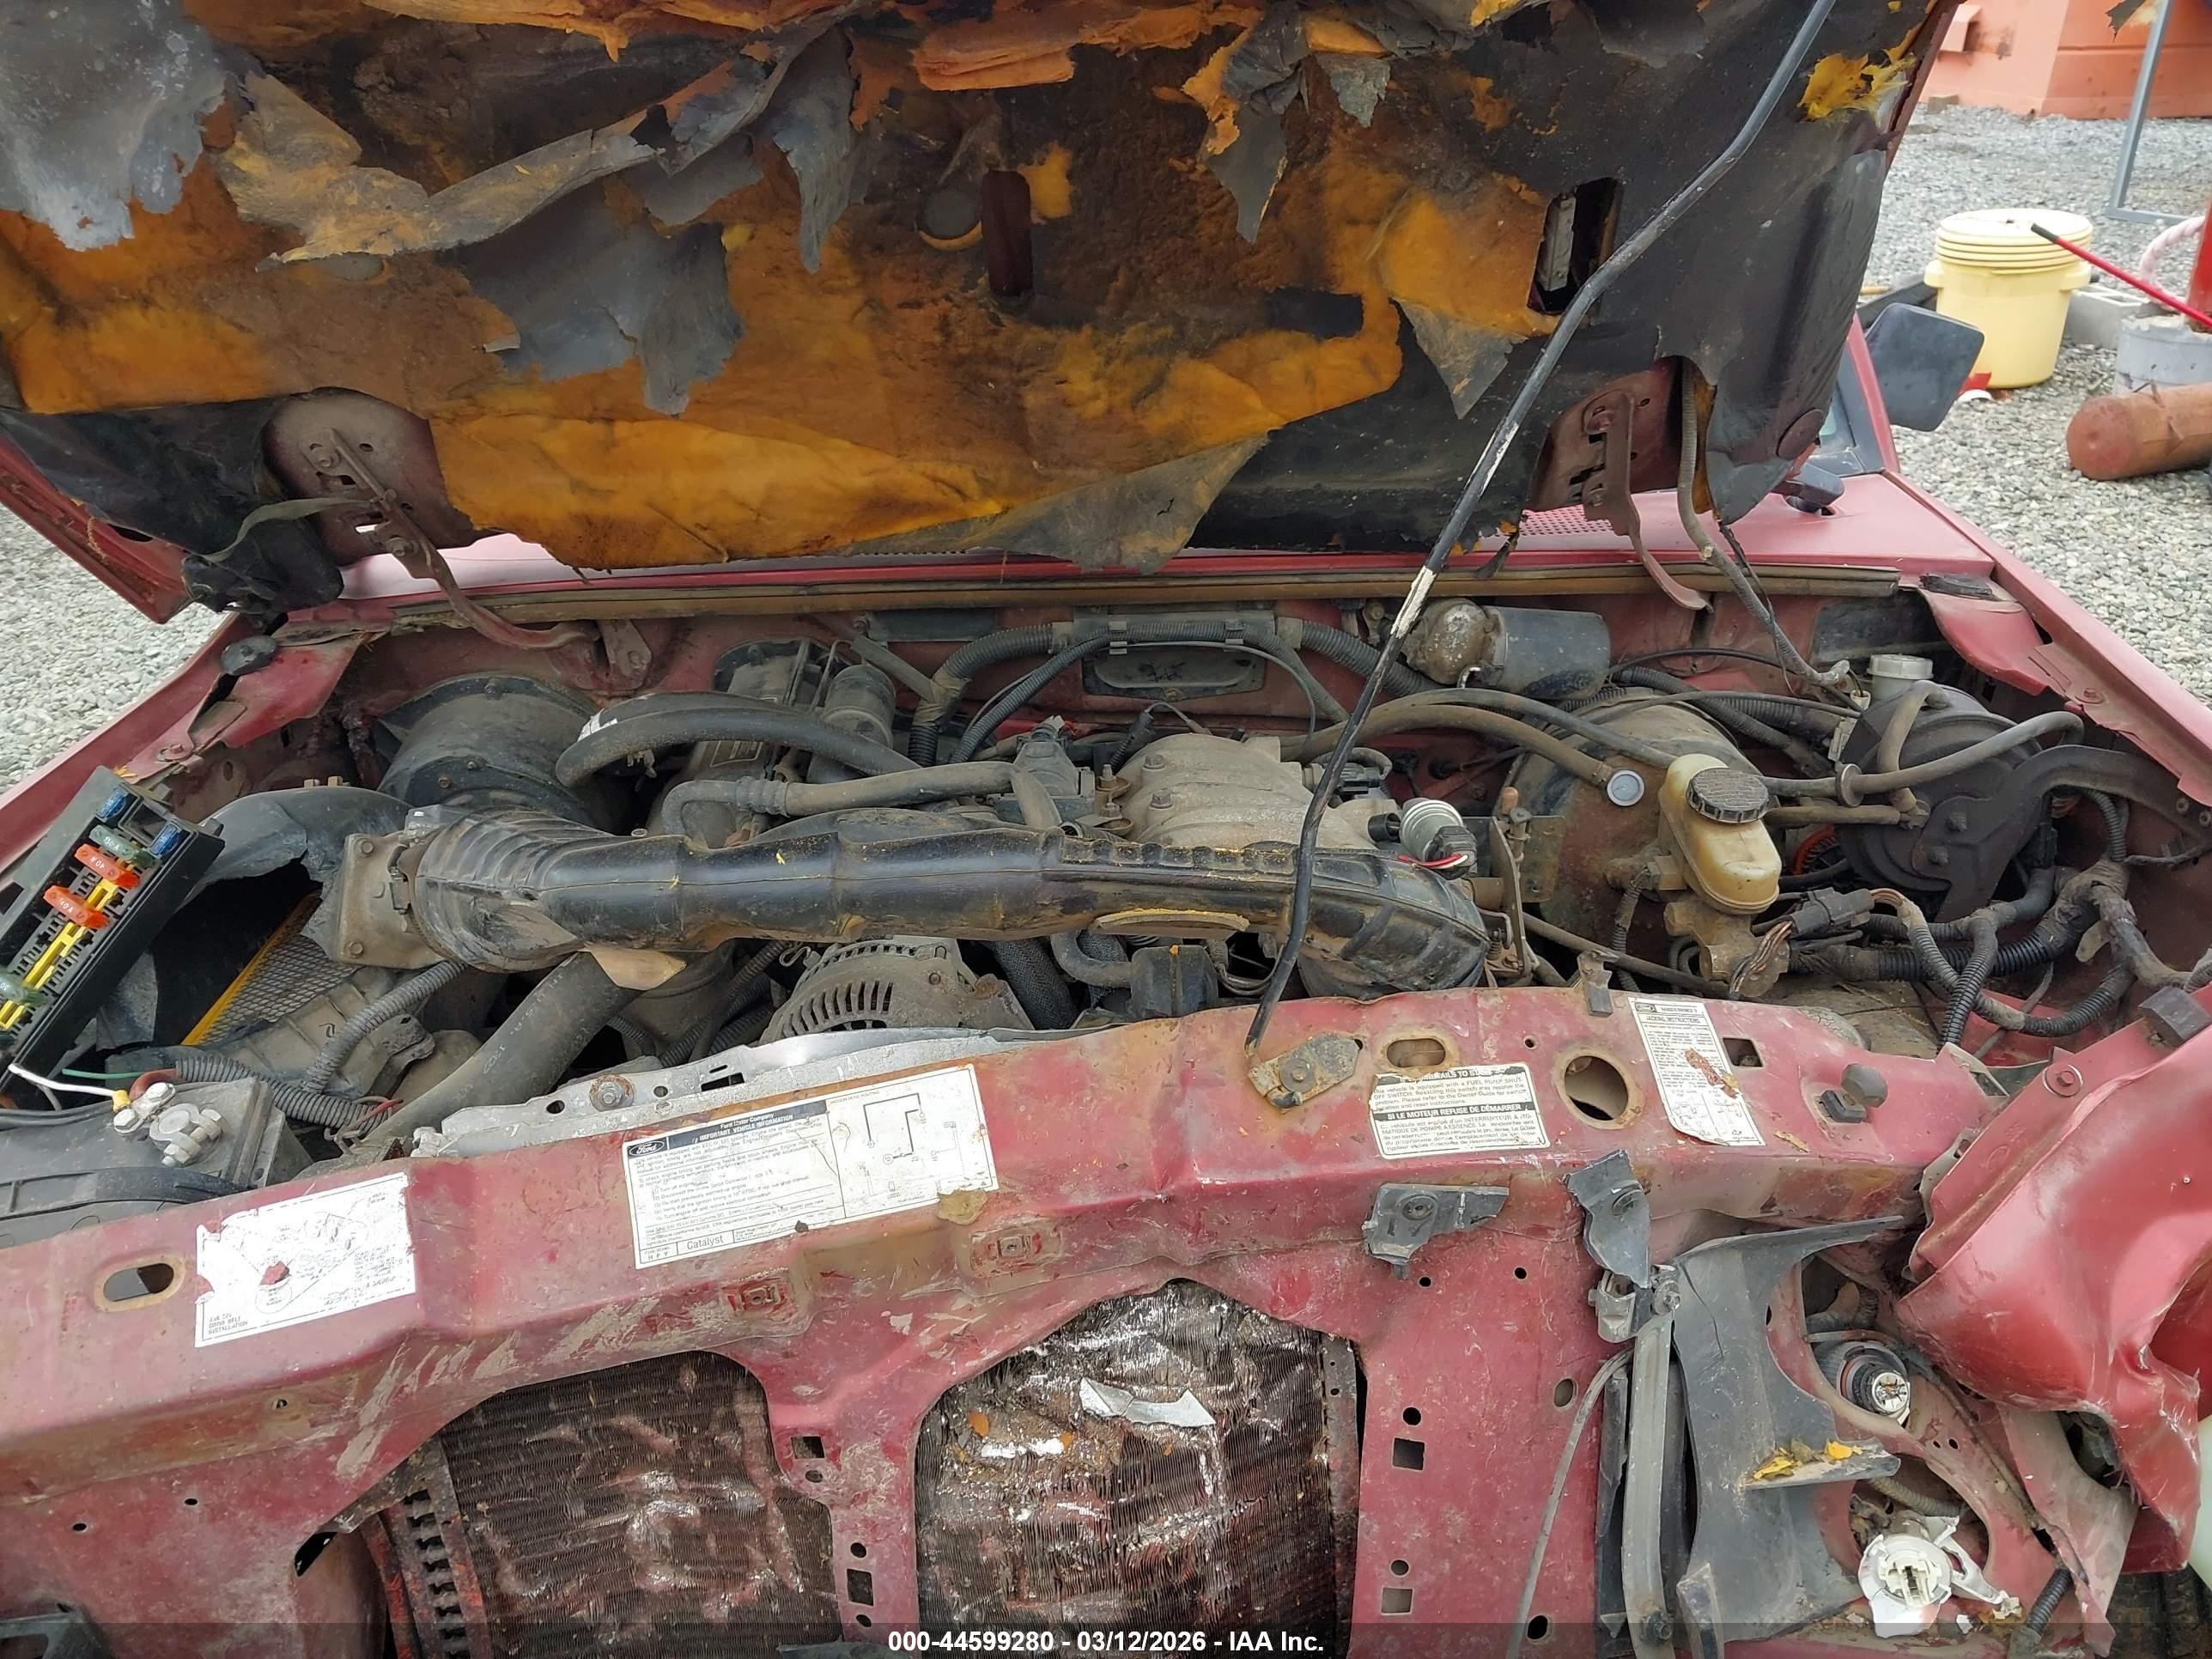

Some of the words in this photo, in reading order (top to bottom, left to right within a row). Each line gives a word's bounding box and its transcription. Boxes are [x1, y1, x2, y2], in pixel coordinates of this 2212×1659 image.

[749, 1112, 774, 1122] Company
[1407, 1109, 1439, 1118] MOTEUR
[1480, 1103, 1521, 1113] DÉMARRER
[699, 1129, 730, 1140] IMPORTANT
[732, 1123, 754, 1133] VEHICLE
[756, 1114, 793, 1127] INFORMATION
[686, 1235, 723, 1250] Catalyst
